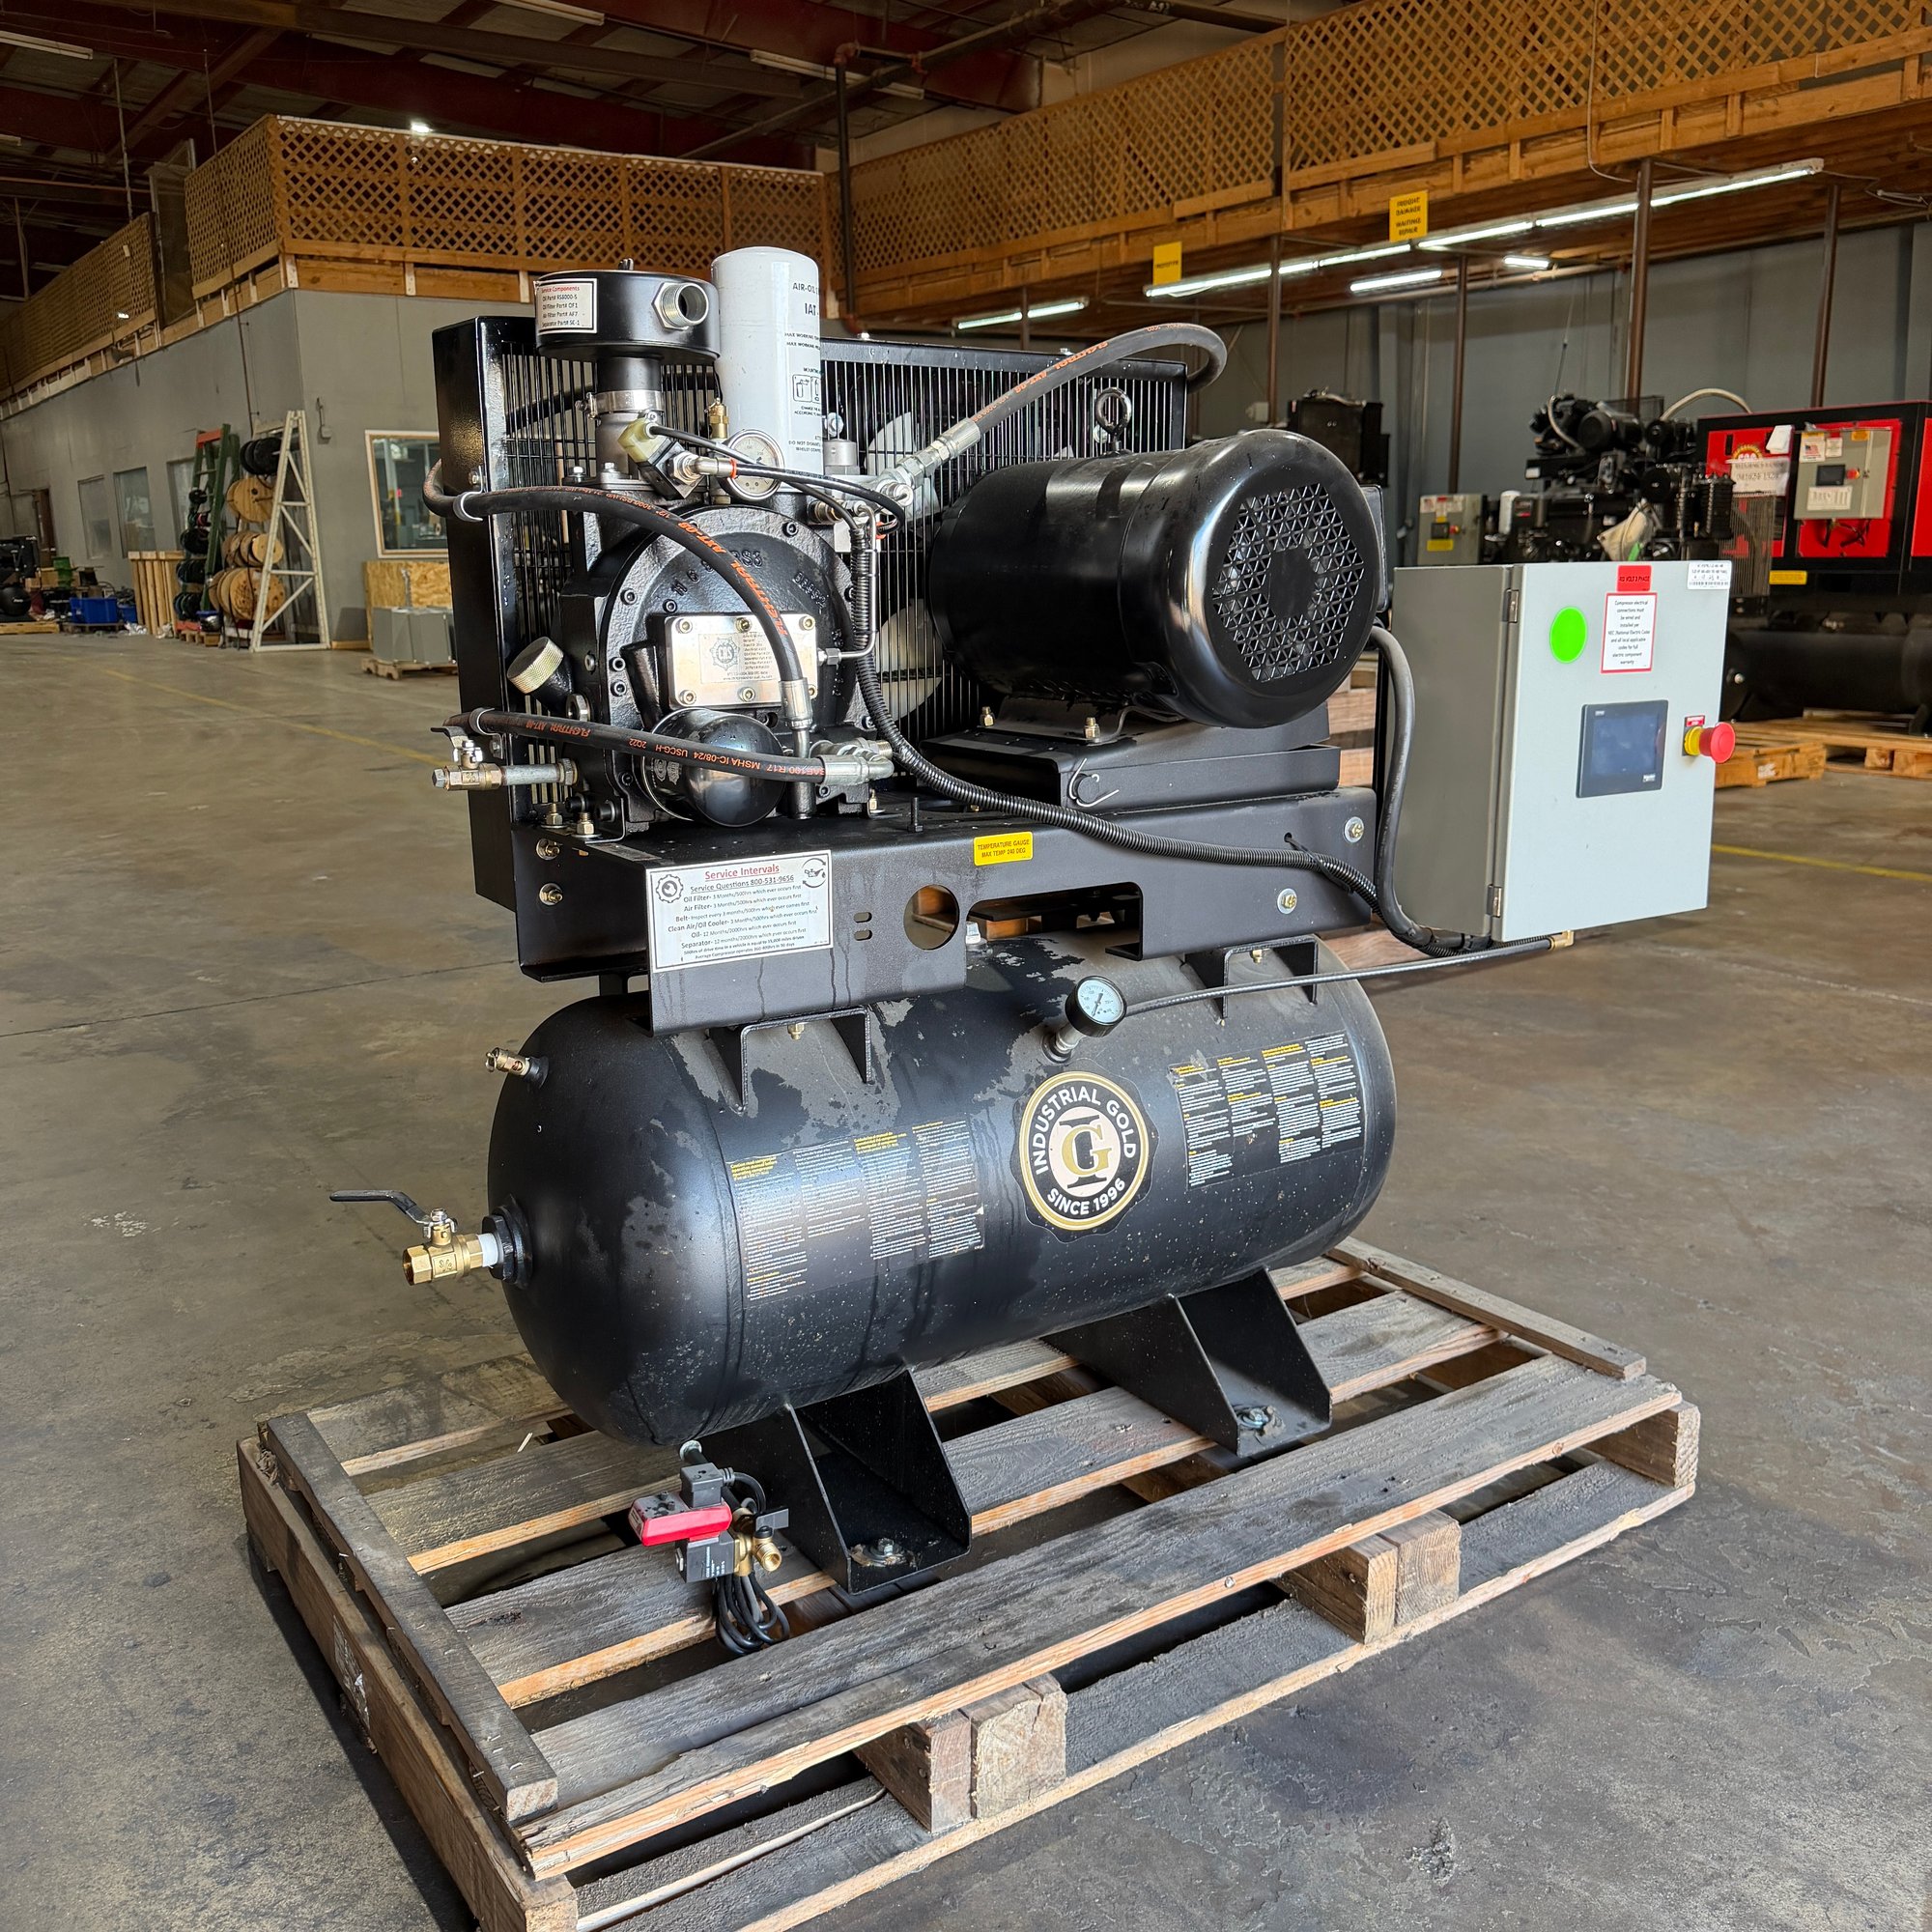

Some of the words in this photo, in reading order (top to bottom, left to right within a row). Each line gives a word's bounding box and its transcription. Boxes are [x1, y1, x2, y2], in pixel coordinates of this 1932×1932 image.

[629, 737, 647, 749] 2022
[655, 744, 689, 757] USCG-H
[694, 751, 729, 765] IC-08/24
[731, 755, 760, 770] MSHA
[767, 764, 785, 773] R17
[978, 841, 1011, 850] TEMPERATURE
[705, 868, 738, 880] Service
[740, 864, 781, 876] Intervals
[690, 884, 715, 893] Service
[716, 881, 750, 891] Questions
[751, 874, 794, 886] 800-531-9656
[686, 922, 706, 930] Air/Oil
[681, 940, 713, 950] Separator-
[1033, 1086, 1102, 1175] INDUSTRIAL
[1105, 1099, 1137, 1158] GOLD
[1047, 1187, 1090, 1215] SINCE
[1093, 1178, 1125, 1211] 1996
